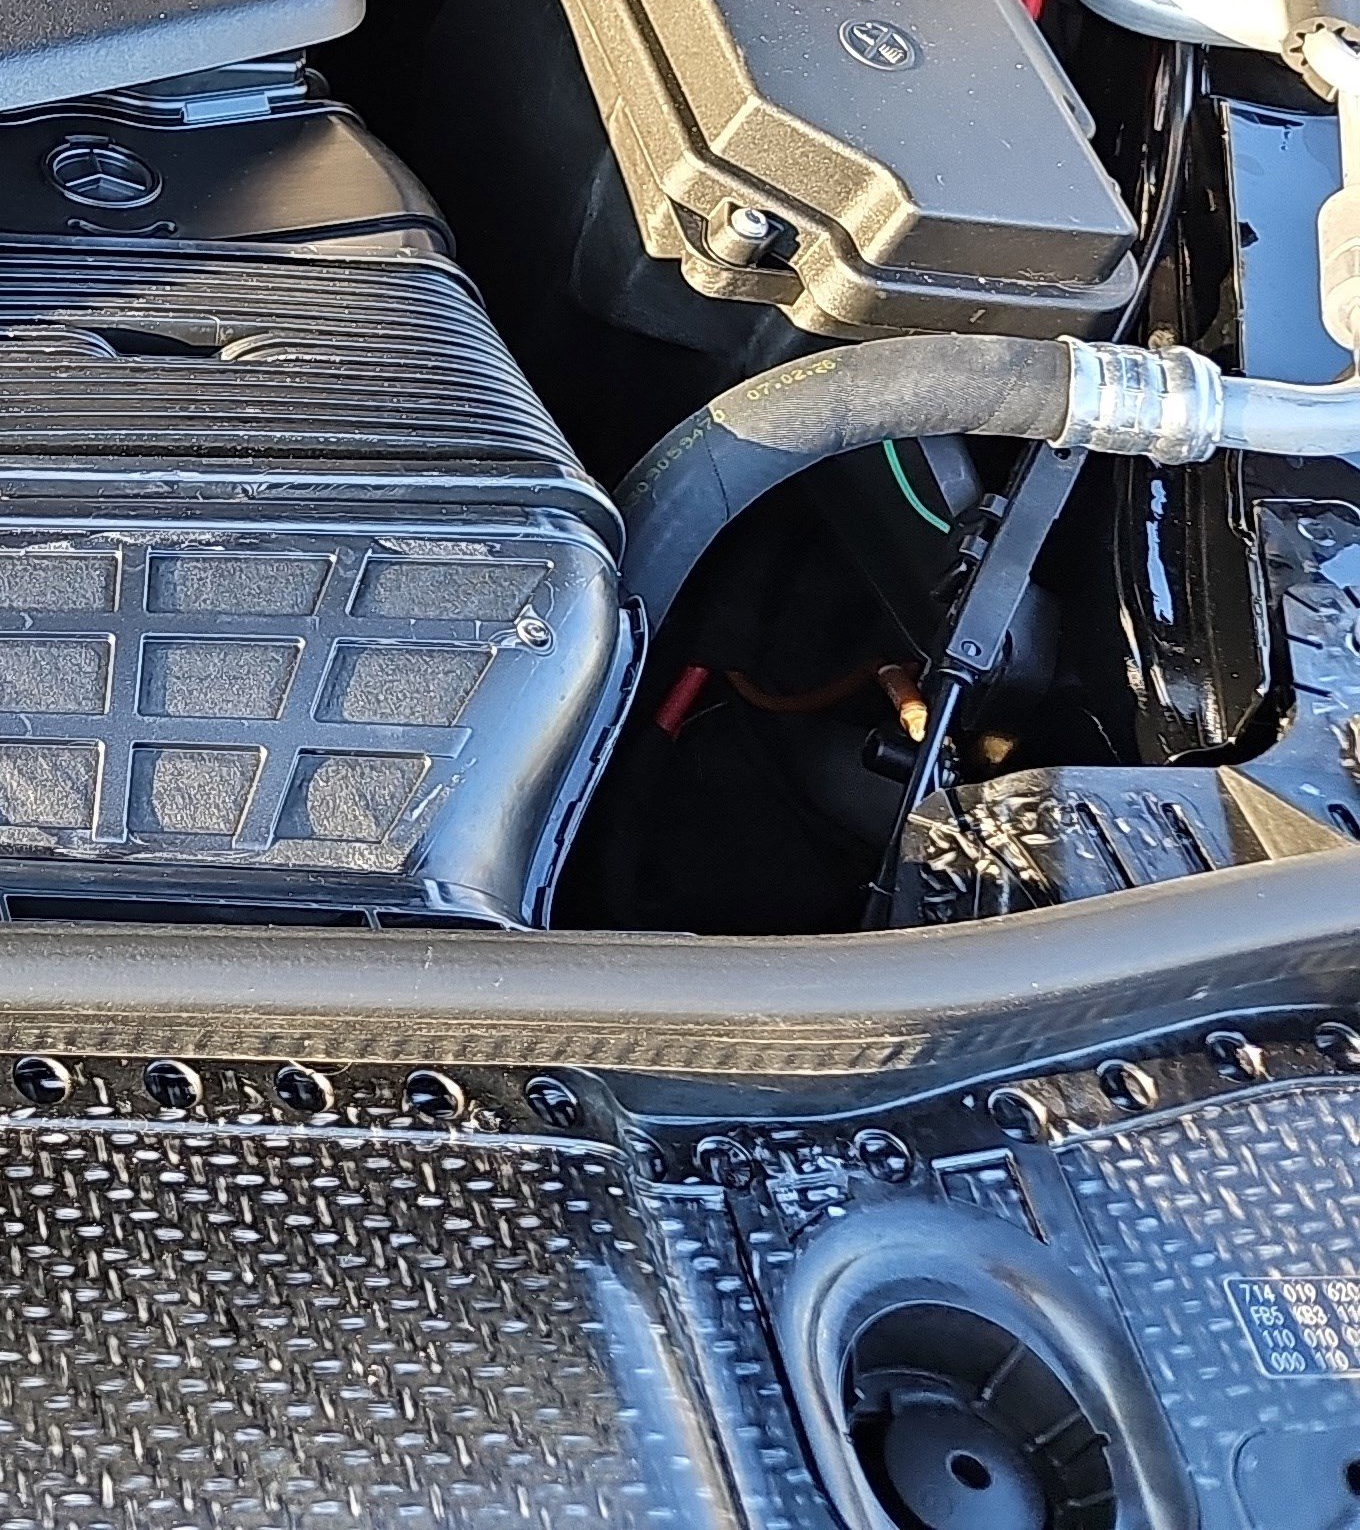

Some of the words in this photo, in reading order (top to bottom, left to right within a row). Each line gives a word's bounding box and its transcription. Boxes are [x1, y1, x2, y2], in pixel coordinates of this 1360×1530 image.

[1239, 1283, 1276, 1304] 714
[1283, 1282, 1317, 1303] 019
[1262, 1328, 1296, 1348] 110
[1303, 1327, 1339, 1348] 010
